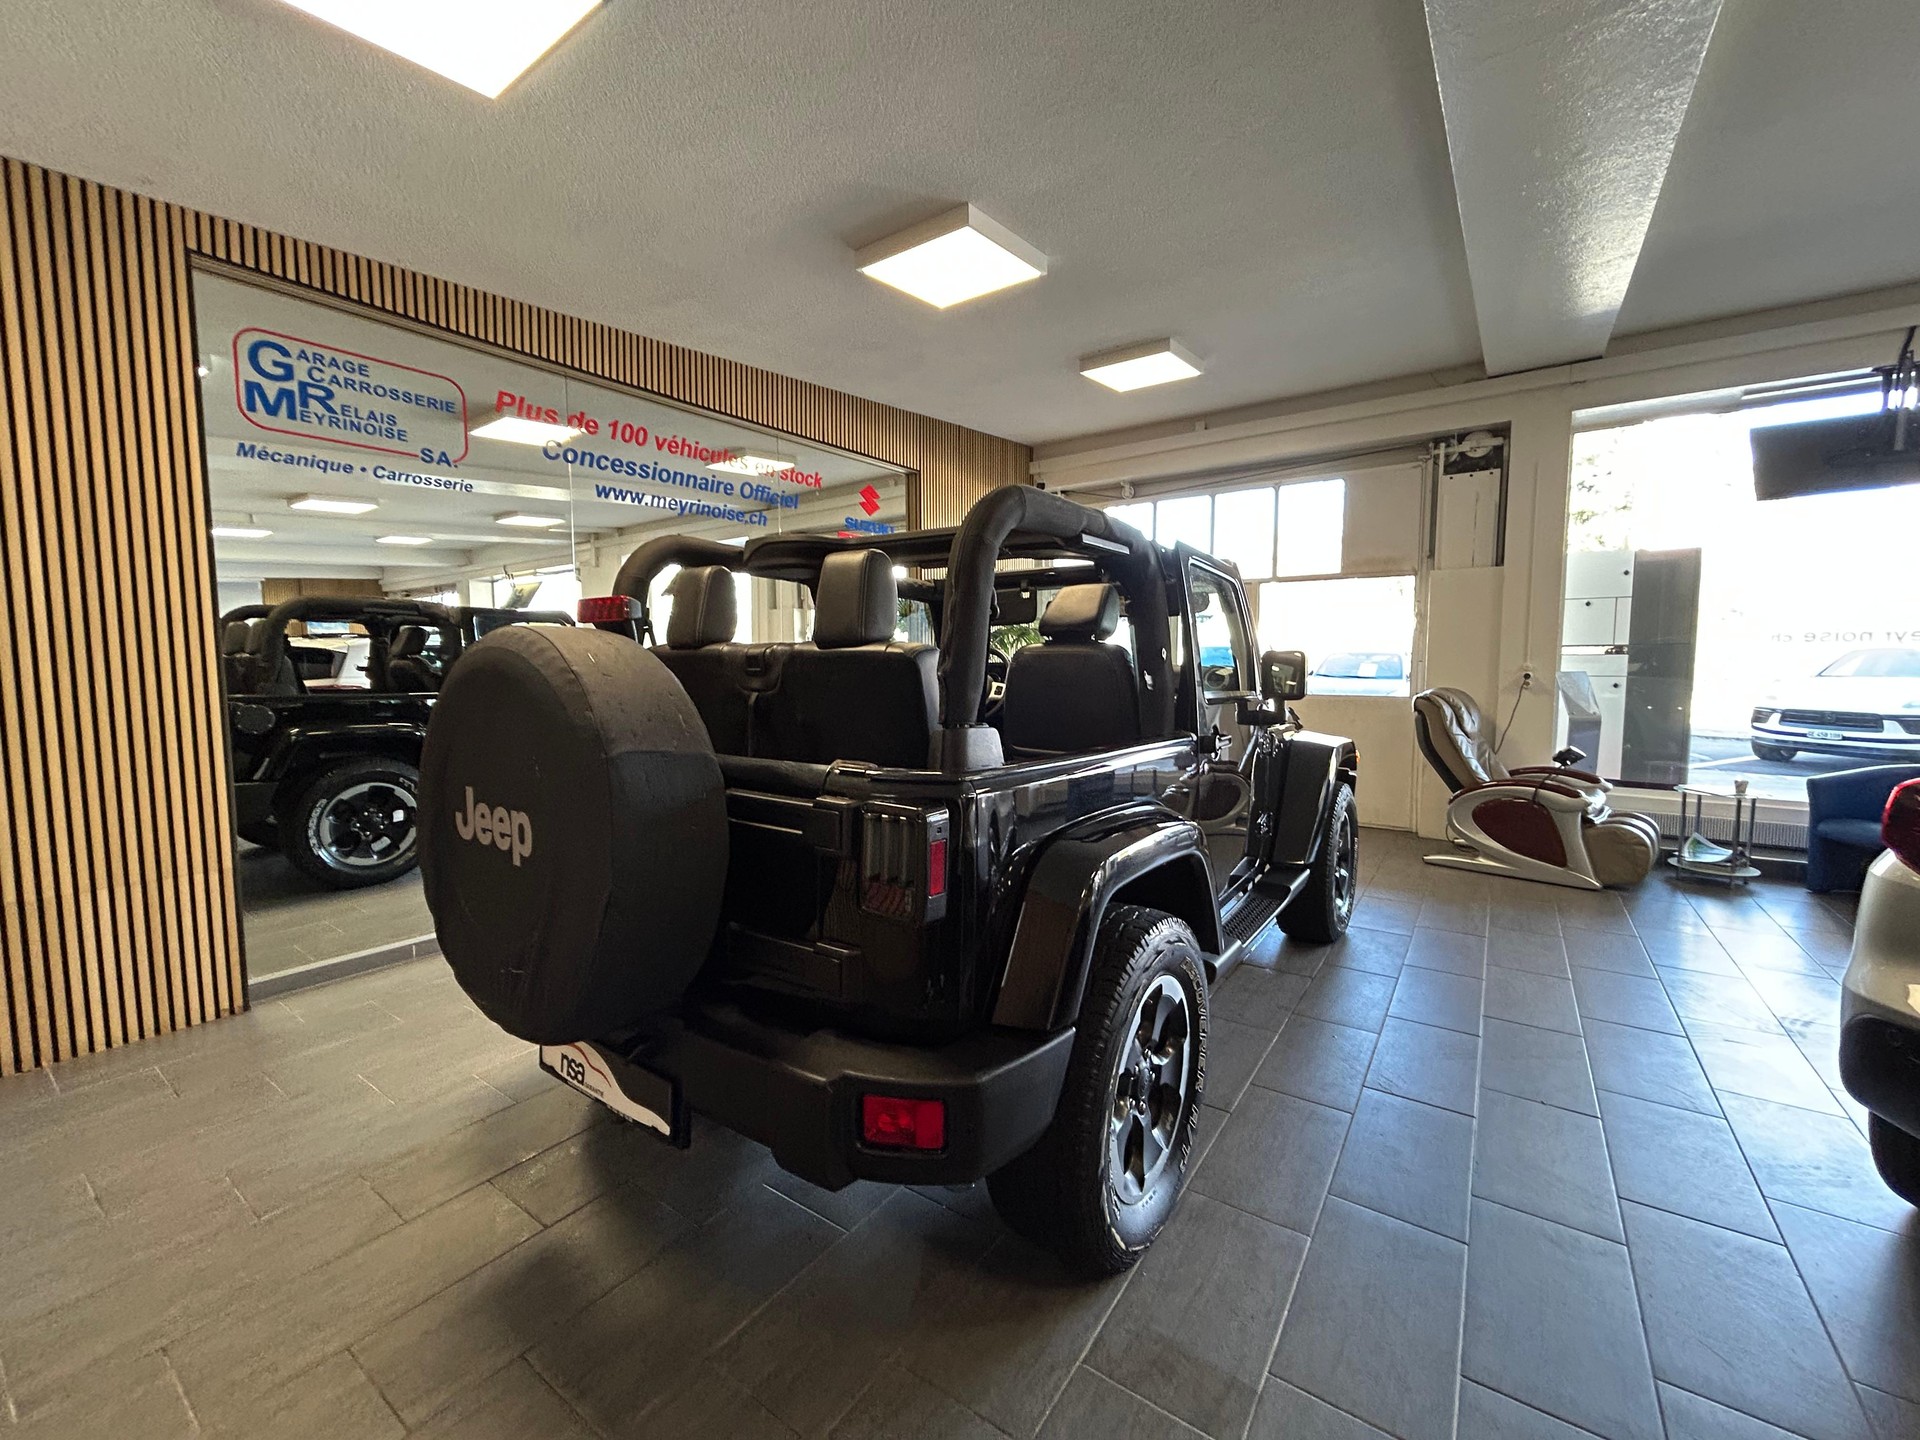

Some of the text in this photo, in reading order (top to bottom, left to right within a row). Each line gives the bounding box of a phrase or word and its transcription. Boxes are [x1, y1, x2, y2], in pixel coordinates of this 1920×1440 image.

[247, 339, 371, 382] GARAGE
[244, 379, 409, 443] MEYRINOISE
[298, 379, 398, 427] RELAIS
[307, 365, 457, 414] CARROSSERIE
[494, 390, 559, 425] Plus
[567, 411, 600, 436] de
[608, 419, 649, 447] 100
[779, 467, 824, 489] stock
[236, 442, 474, 493] Mécanique Carrosserie
[542, 439, 799, 510] Concessionnaire Officiel
[595, 483, 768, 527] www.meyrinoise.ch
[455, 785, 533, 867] Jeep
[560, 1053, 586, 1085] nsa
